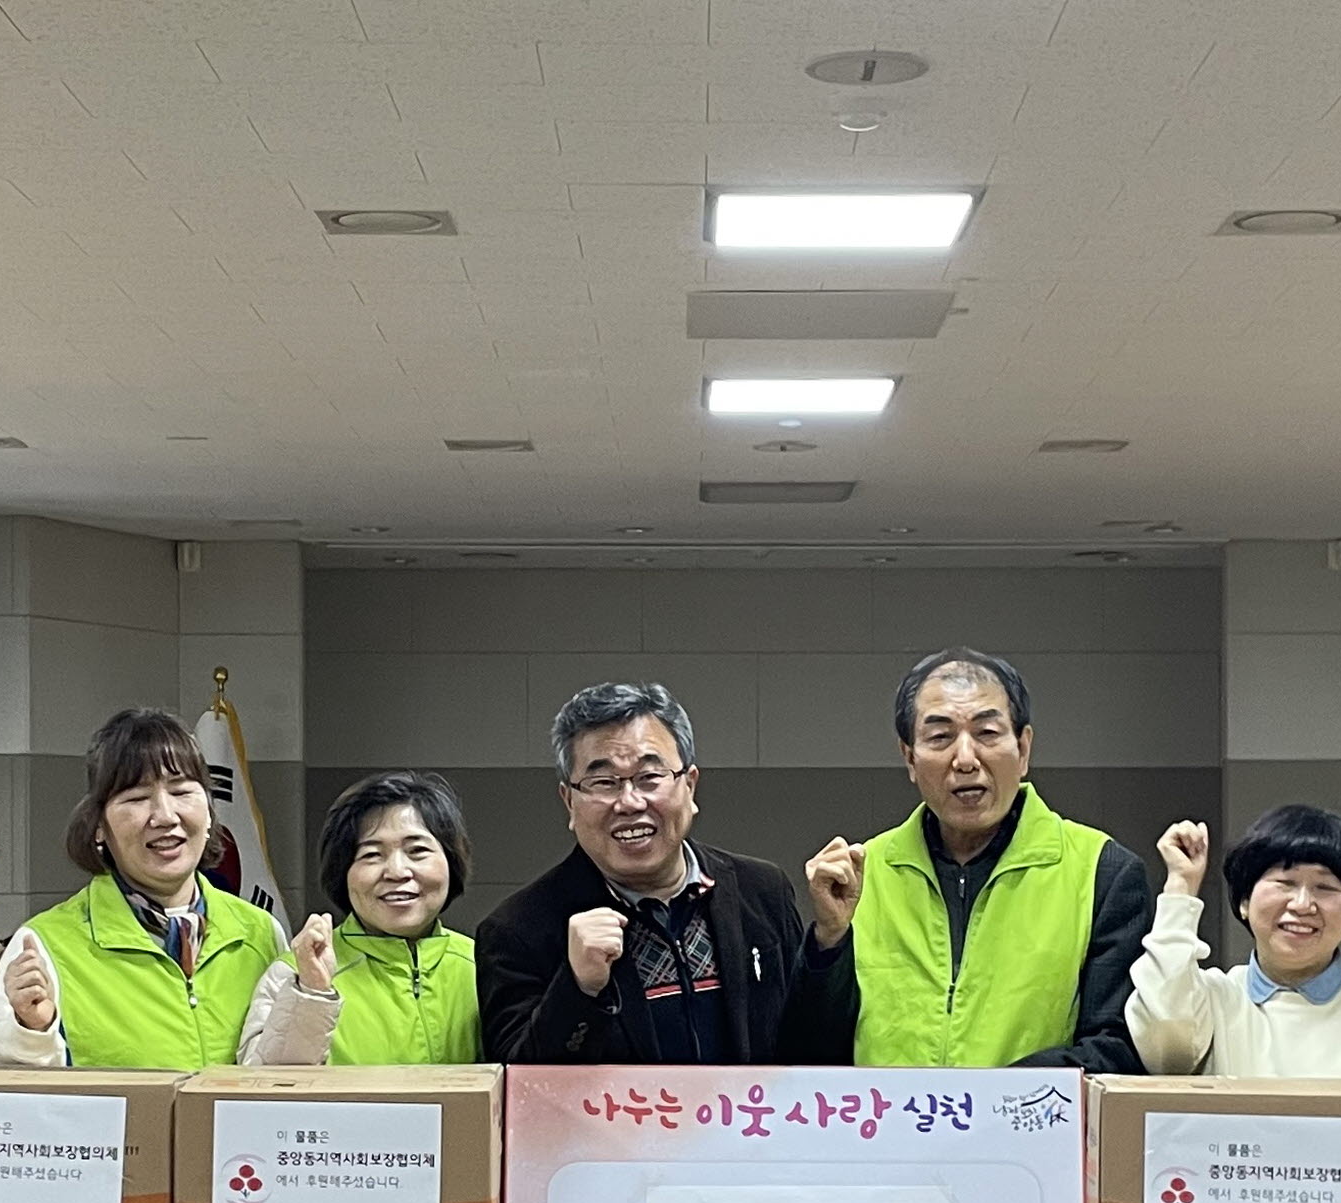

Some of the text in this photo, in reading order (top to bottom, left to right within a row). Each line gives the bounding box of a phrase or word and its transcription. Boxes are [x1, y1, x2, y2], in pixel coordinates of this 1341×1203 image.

[583, 1088, 683, 1129] 나누는
[696, 1084, 775, 1137] 이웃
[785, 1088, 891, 1139] 사랑
[903, 1092, 972, 1132] 실천
[277, 1151, 435, 1168] 중앙동지역사회보장협의체
[276, 1174, 299, 1187] 에서
